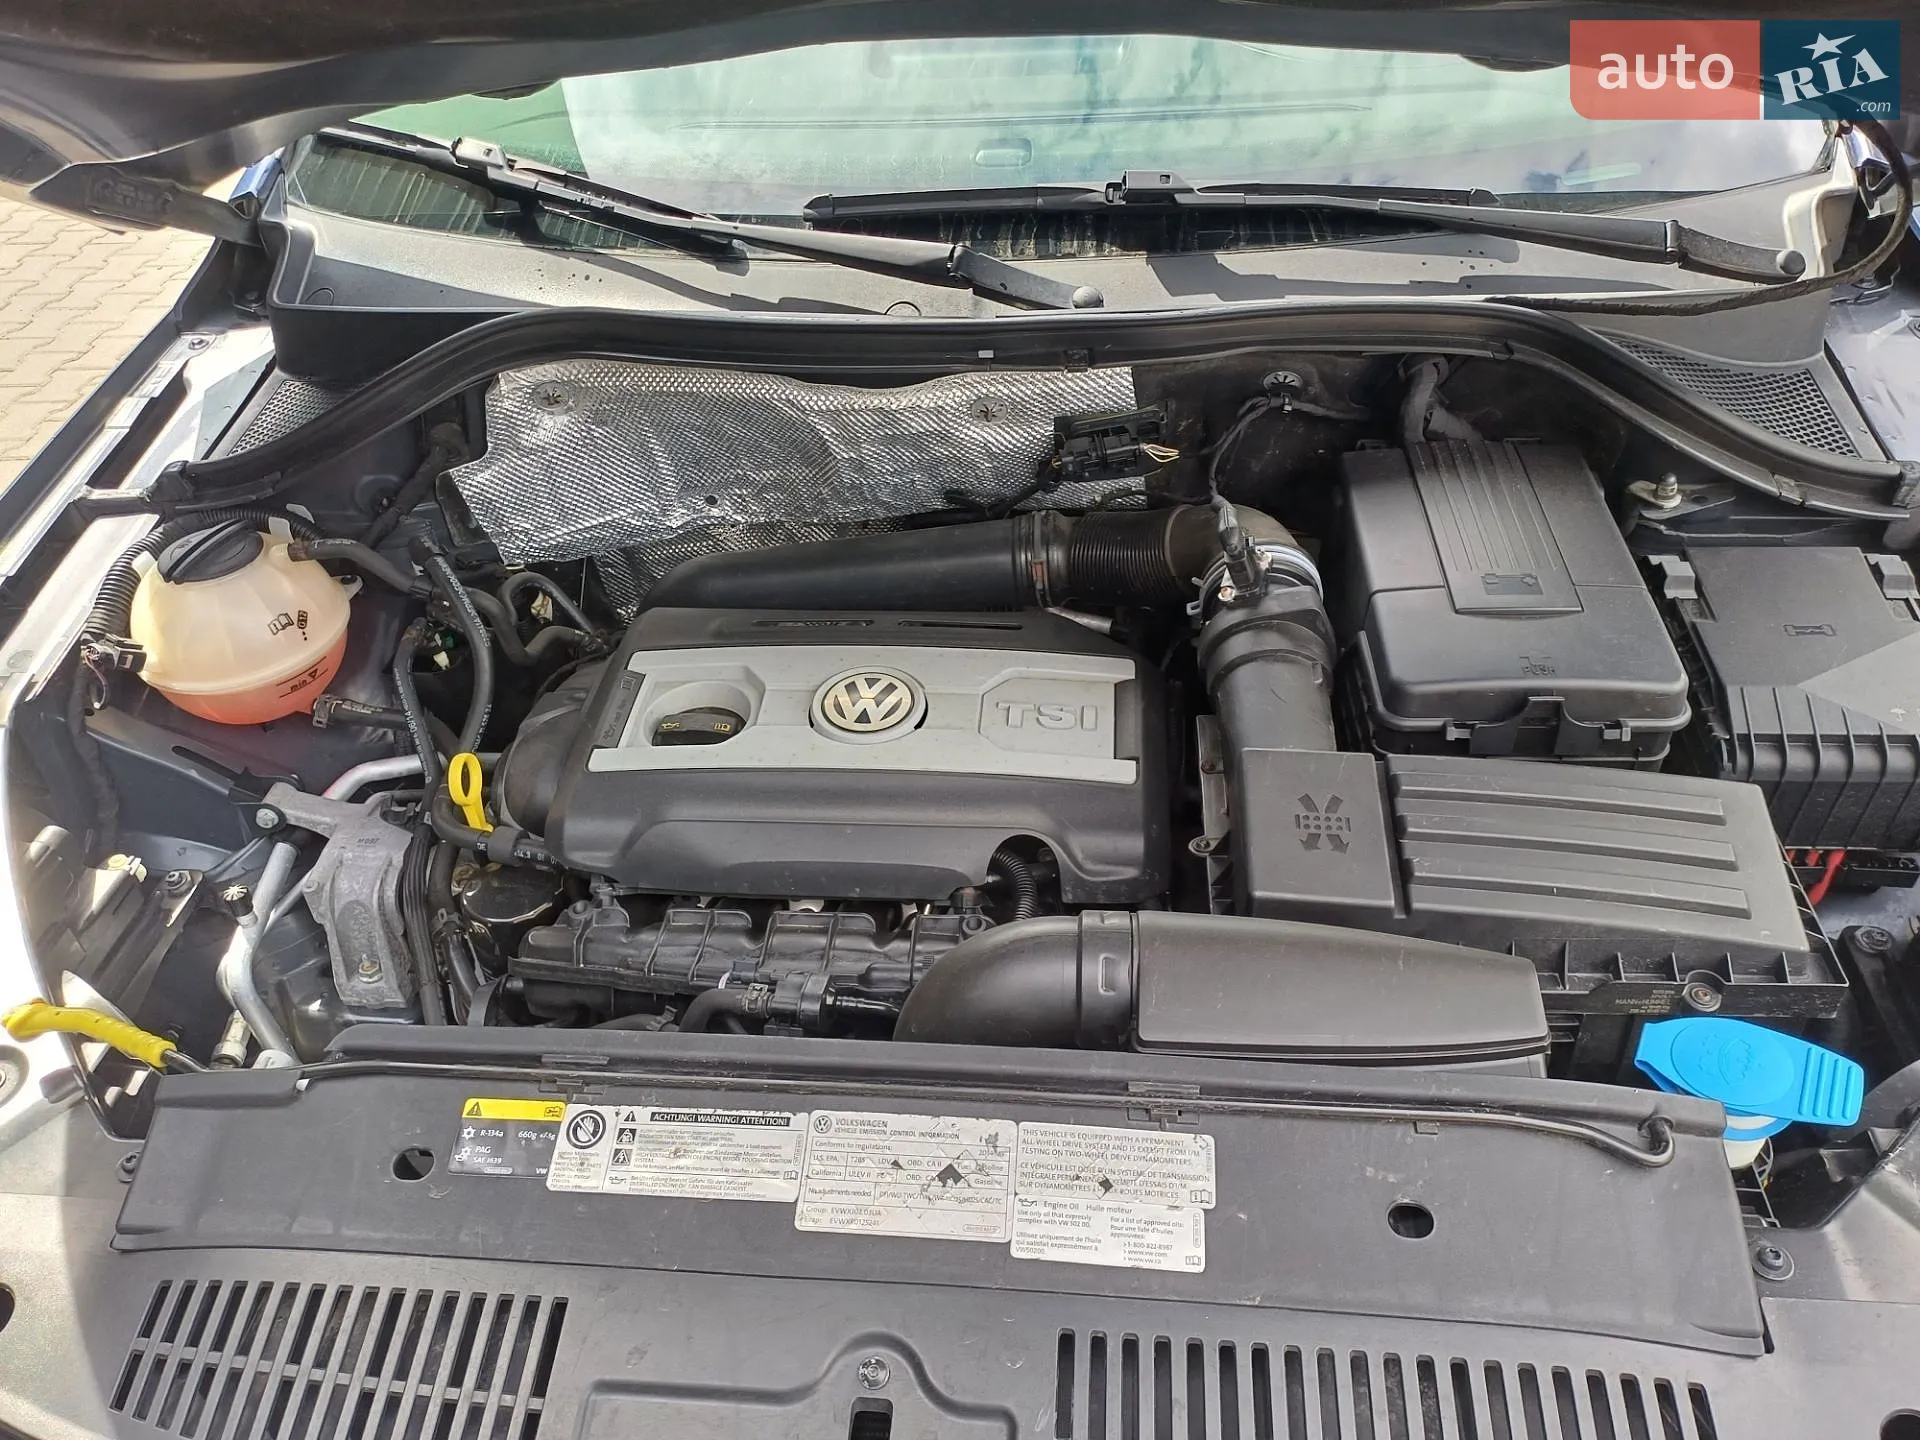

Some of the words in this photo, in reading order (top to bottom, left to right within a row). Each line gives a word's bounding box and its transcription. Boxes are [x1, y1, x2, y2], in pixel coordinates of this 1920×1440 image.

[290, 679, 307, 693] min
[996, 700, 1098, 732] TSI
[653, 1113, 696, 1122] ACHTUNG!
[697, 1114, 739, 1124] WARNING!
[740, 1116, 788, 1126] ATTENTION!
[835, 1117, 889, 1128] VOLKSWAGEN
[518, 1131, 537, 1140] 660g
[1040, 1129, 1067, 1138] VEHICLE
[475, 1146, 491, 1154] PAG
[1084, 1142, 1111, 1151] SYSTEM
[1112, 1143, 1128, 1151] AND
[1021, 1147, 1051, 1155] TESTING
[1052, 1149, 1063, 1157] ON
[1043, 1200, 1068, 1210] Engine
[1069, 1202, 1080, 1210] Oil
[1106, 1206, 1132, 1214] moteur
[1143, 1219, 1171, 1227] approved
